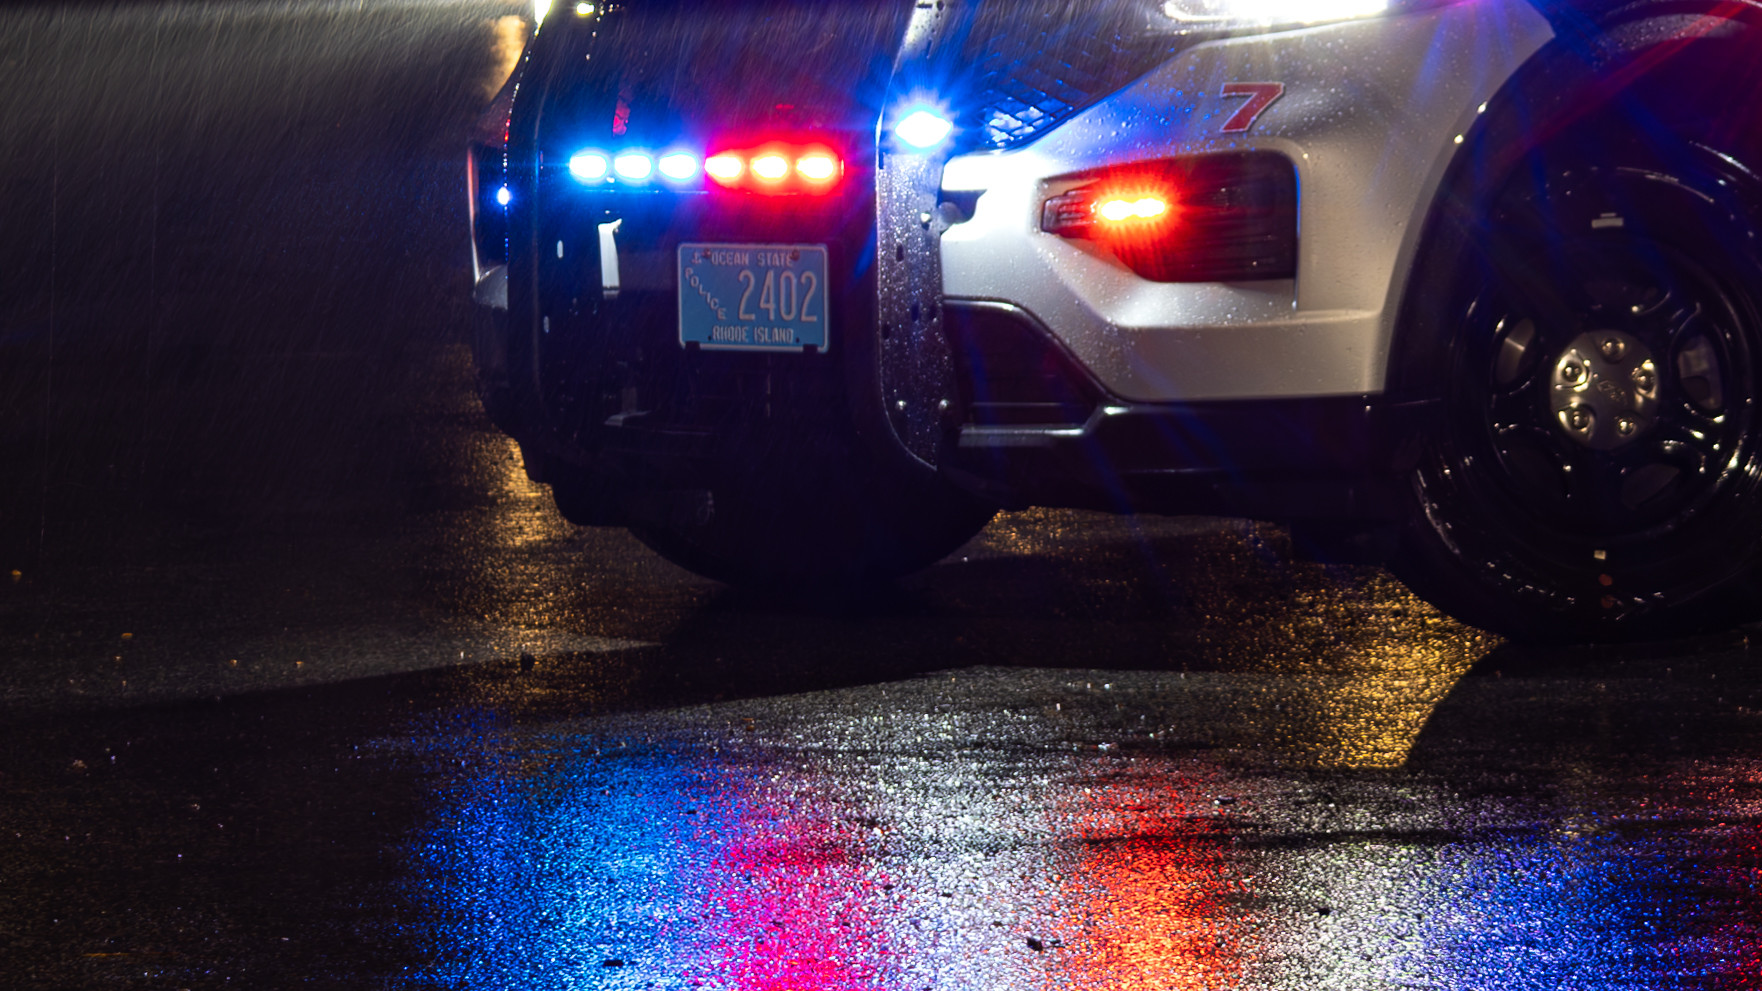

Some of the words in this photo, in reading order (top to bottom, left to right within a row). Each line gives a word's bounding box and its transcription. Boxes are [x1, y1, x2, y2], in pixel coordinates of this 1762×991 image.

[1220, 81, 1286, 133] 7
[711, 251, 749, 266] OCEAN
[757, 252, 793, 267] STATE
[685, 267, 727, 321] POLICE
[738, 269, 818, 322] 2402
[712, 325, 749, 342] RHODE
[754, 326, 794, 344] ISLAND
